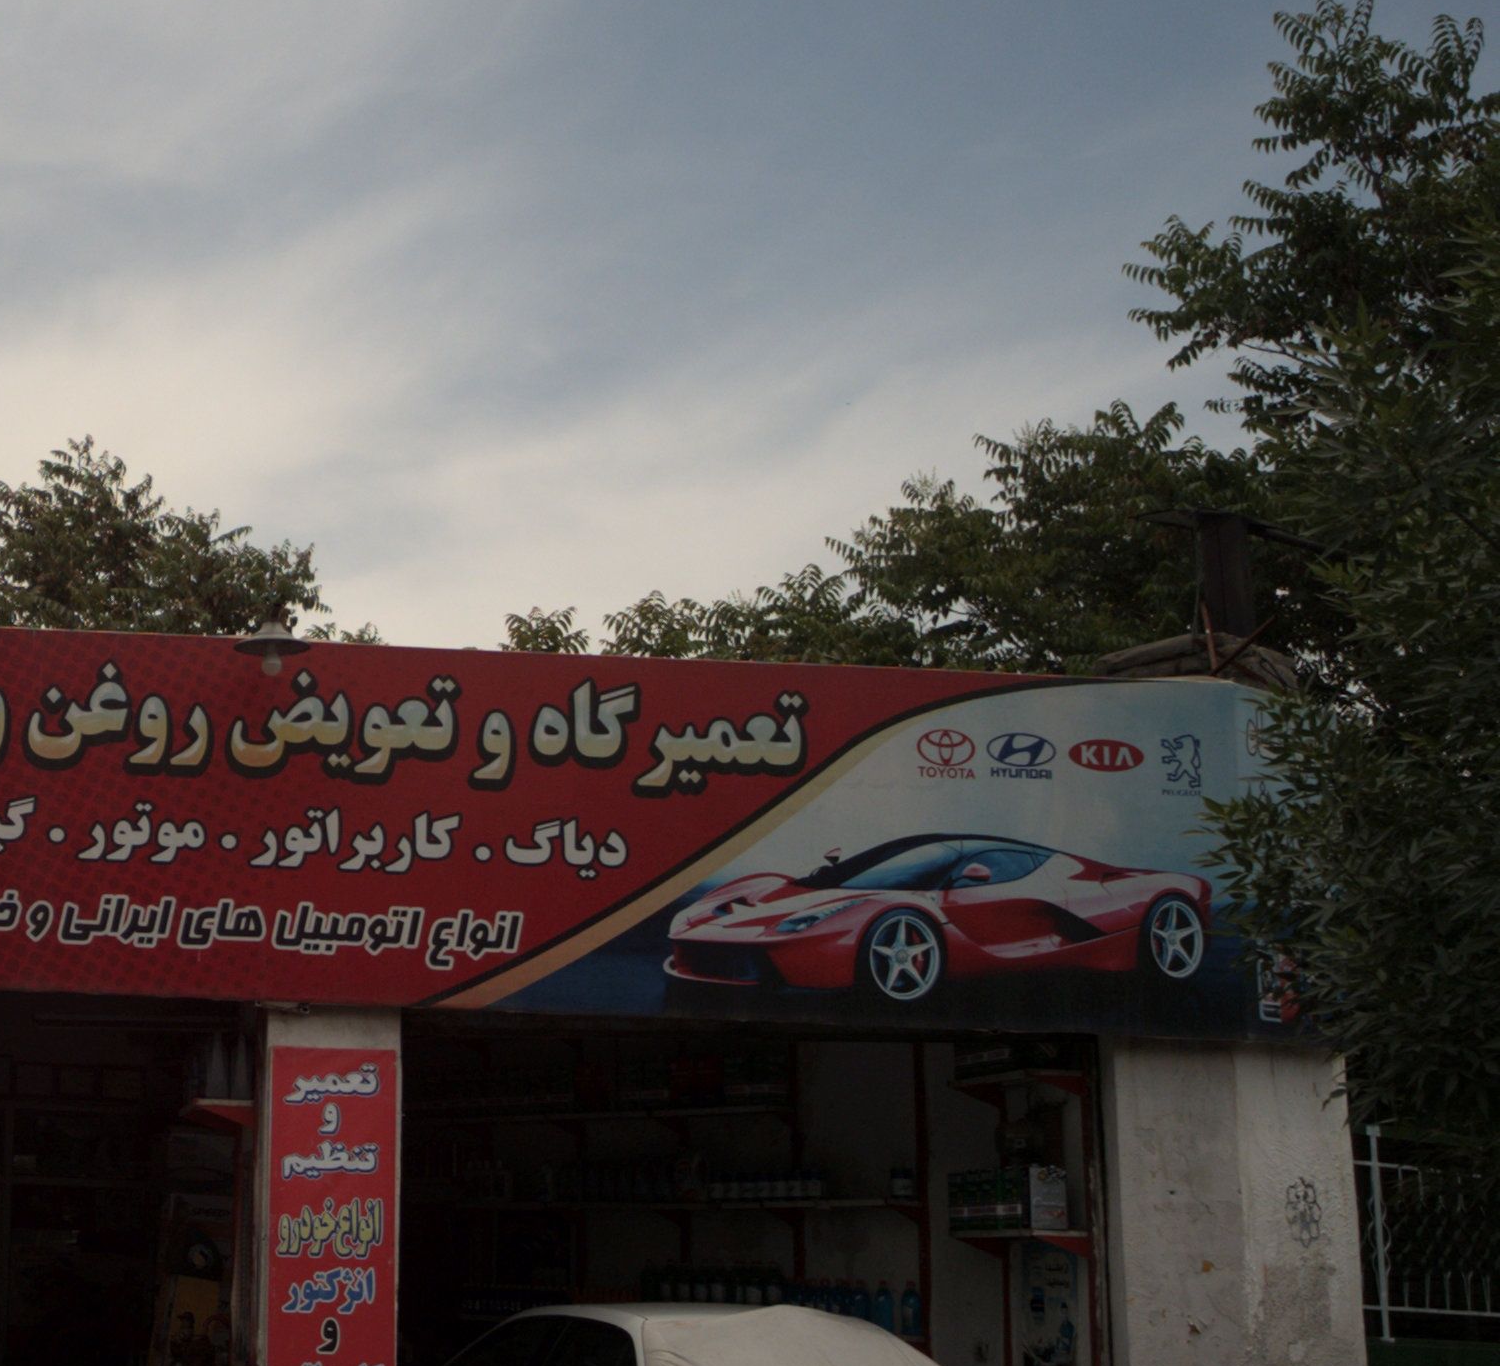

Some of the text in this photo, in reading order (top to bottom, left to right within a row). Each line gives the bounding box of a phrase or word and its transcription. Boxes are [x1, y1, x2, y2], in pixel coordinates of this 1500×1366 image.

[26, 660, 208, 767] روغن
[230, 669, 460, 774] تعویض
[472, 708, 512, 780] و
[1080, 746, 1134, 766] KIA
[918, 766, 976, 779] TOYOTA
[990, 767, 1053, 780] HYUNDAI
[77, 802, 207, 863] موتور
[249, 808, 461, 872] کاربراتور
[504, 819, 628, 879] دیاگ
[26, 898, 53, 942] و
[58, 894, 176, 948] ایرانی
[177, 898, 265, 949] های
[273, 902, 425, 954] اتومبیل
[427, 909, 523, 969] انواع
[284, 1063, 380, 1104] تعمیر
[318, 1102, 341, 1134] و
[281, 1141, 378, 1179] تنظیم
[276, 1197, 383, 1258] انواع خودرو
[282, 1267, 376, 1314] انژکتور
[316, 1318, 340, 1354] و
